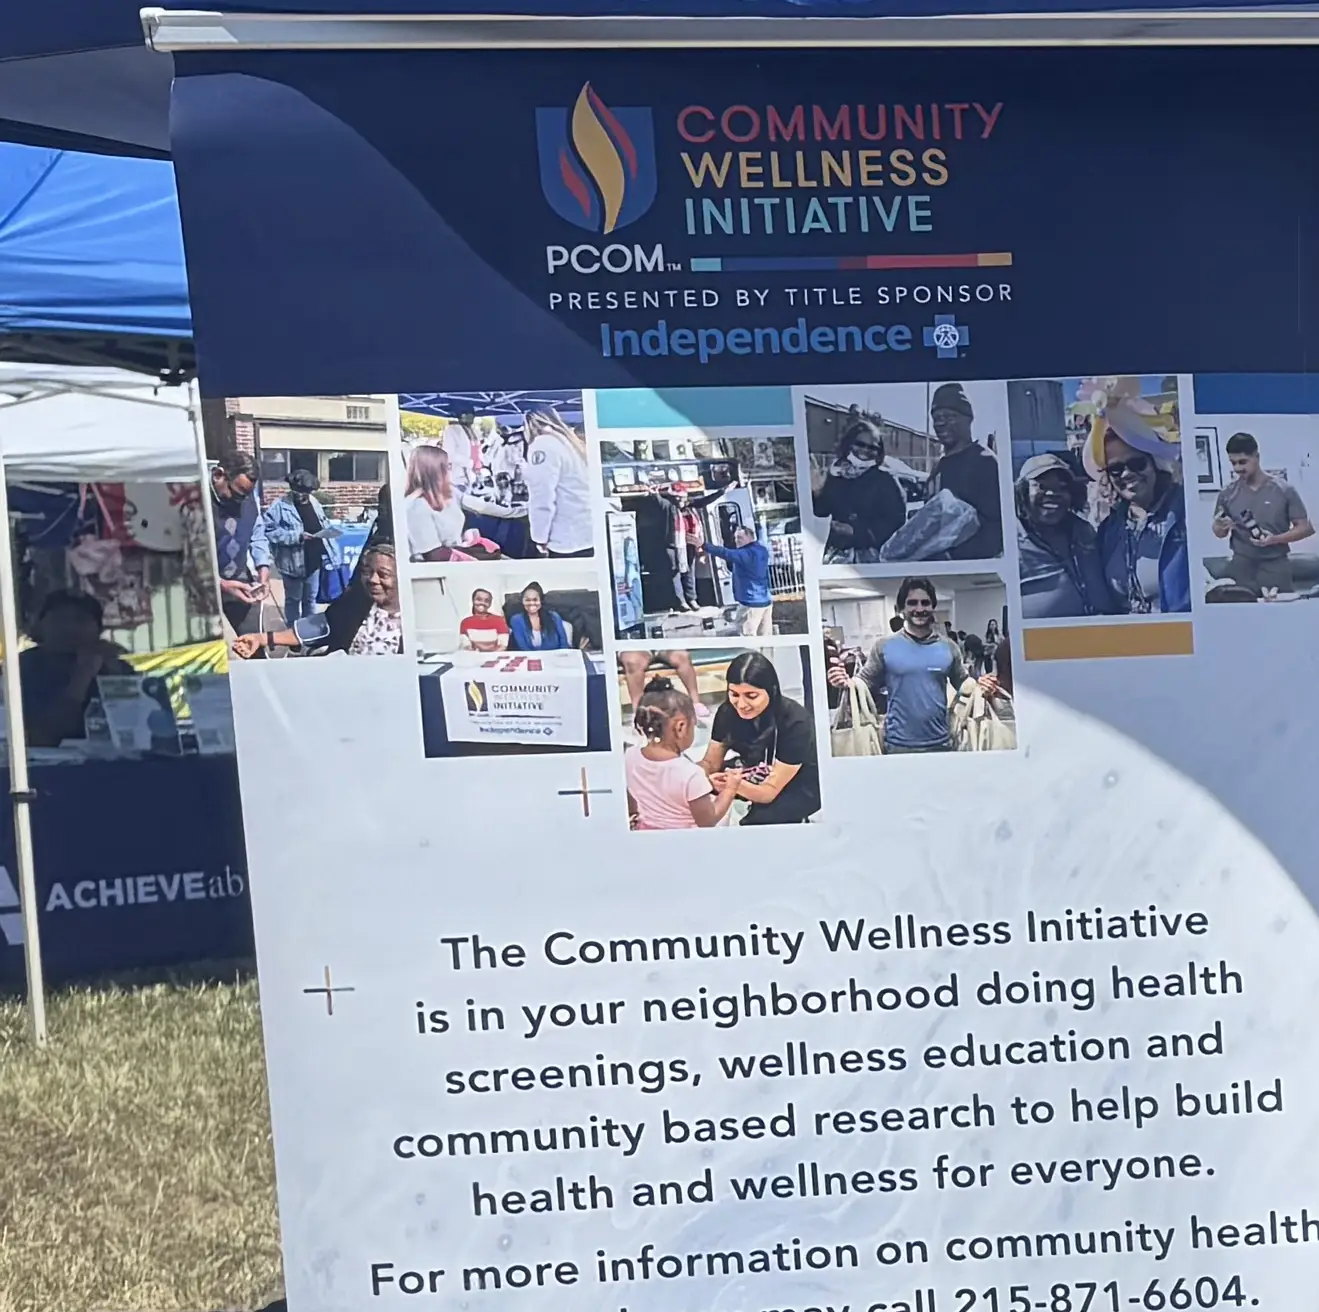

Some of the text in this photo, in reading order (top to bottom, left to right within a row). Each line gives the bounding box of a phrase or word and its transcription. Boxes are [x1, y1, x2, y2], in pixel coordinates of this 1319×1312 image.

[677, 102, 1003, 143] COMMUNITY
[680, 147, 949, 188] WELLNESS
[685, 195, 932, 235] INITIATIVE
[546, 244, 664, 274] PCOM
[549, 283, 1012, 310] PRESENTED BY TITLE SPONSOR
[600, 317, 912, 363] Independence
[45, 865, 244, 912] ACHIEVEab
[441, 904, 1209, 971] The Community Wellness Initiative
[416, 959, 1243, 1040] is in your neighborhood doing health
[445, 1020, 1223, 1095] screenings, wellness education and
[393, 1077, 1283, 1159] community based research to help build
[472, 1150, 1215, 1217] health and wellness for everyone.
[371, 1262, 446, 1297] For
[462, 1261, 580, 1292] more
[596, 1237, 859, 1283] information
[876, 1240, 929, 1266] on
[945, 1219, 1175, 1262] community
